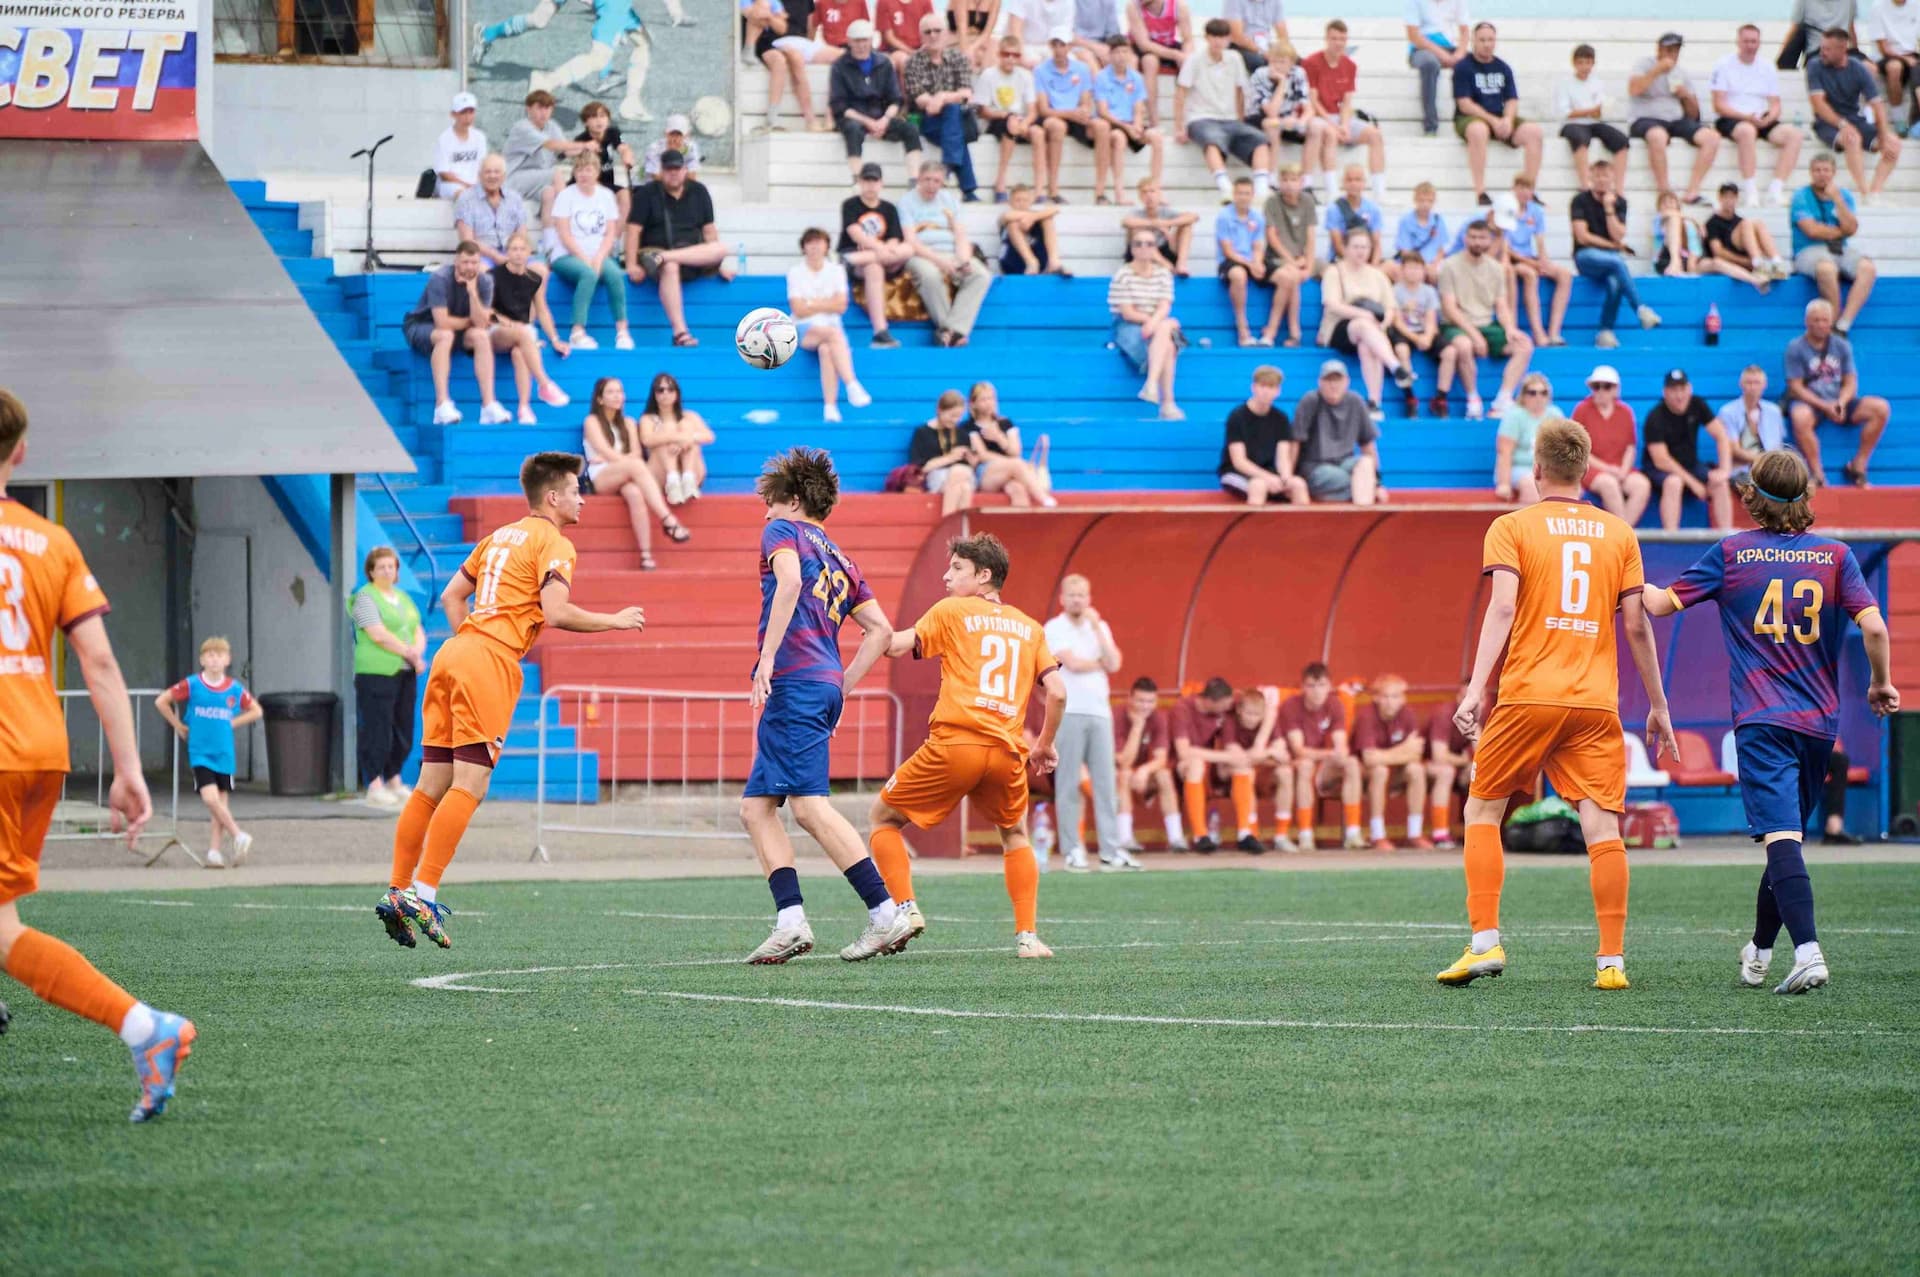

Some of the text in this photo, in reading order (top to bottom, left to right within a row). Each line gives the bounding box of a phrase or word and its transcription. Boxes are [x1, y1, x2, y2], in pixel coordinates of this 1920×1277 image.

[118, 8, 186, 20] РЕЗЕРВА
[1545, 517, 1605, 538] КНЯЗЕВ
[1736, 548, 1834, 565] КРАСНОЯРСК
[480, 546, 510, 605] 11
[812, 561, 850, 625] 42
[1562, 541, 1591, 614] 6
[1545, 616, 1599, 634] SEBS
[1753, 578, 1824, 645] 43
[980, 634, 1021, 701] 21
